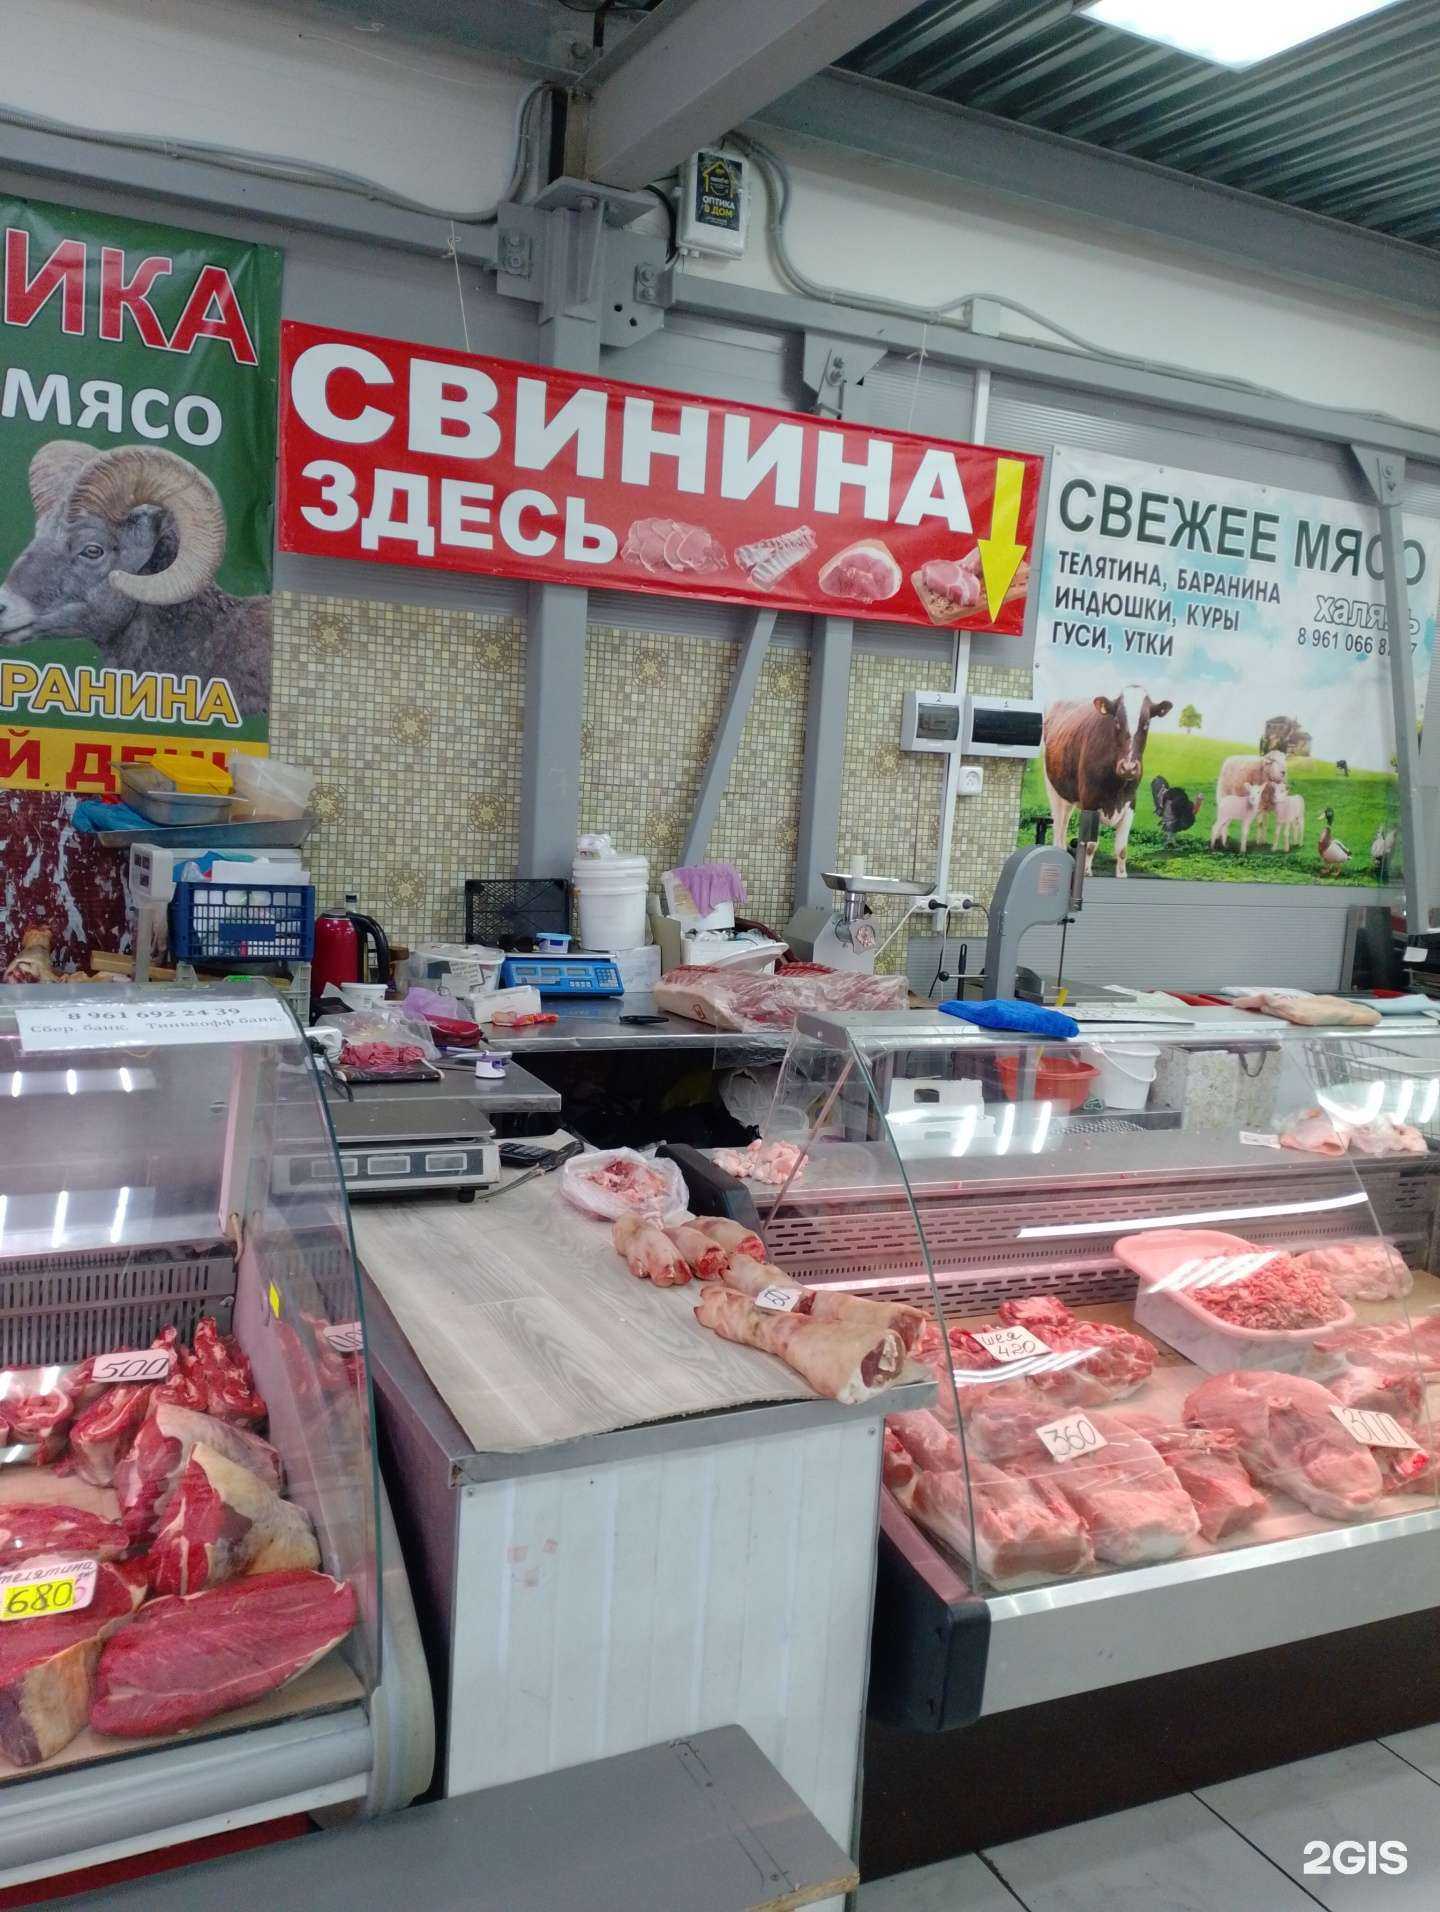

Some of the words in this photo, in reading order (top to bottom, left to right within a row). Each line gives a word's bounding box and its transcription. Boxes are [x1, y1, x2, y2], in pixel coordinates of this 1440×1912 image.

[4, 228, 258, 367] ИКА
[2, 367, 223, 447] МЯСО
[290, 342, 974, 534] СВИНИНА
[300, 460, 619, 566] ЗДЕСЬ
[1059, 478, 1280, 563] СВЕЖЕЕ
[1058, 550, 1168, 592] ТЕЛЯТИНА,
[1177, 568, 1281, 604] БАРАНИНА
[1054, 586, 1177, 627] ИНДЮШКИ,
[1186, 603, 1240, 631] КУРЫ
[1313, 594, 1421, 636] халяь
[1052, 621, 1113, 654] ГУСИ,
[1124, 629, 1174, 657] УТКИ
[1297, 627, 1307, 645] 8
[1312, 629, 1339, 649] 961
[1345, 633, 1374, 654] 066
[0, 661, 242, 727] РАНИНА
[87, 1012, 129, 1020] 961
[137, 1008, 178, 1019] 692
[182, 1009, 209, 1017] 24
[215, 1007, 241, 1016] 39
[92, 1358, 169, 1379] 500
[998, 1340, 1036, 1358] 420
[1043, 1420, 1096, 1456] 360
[7, 1581, 73, 1614] 680
